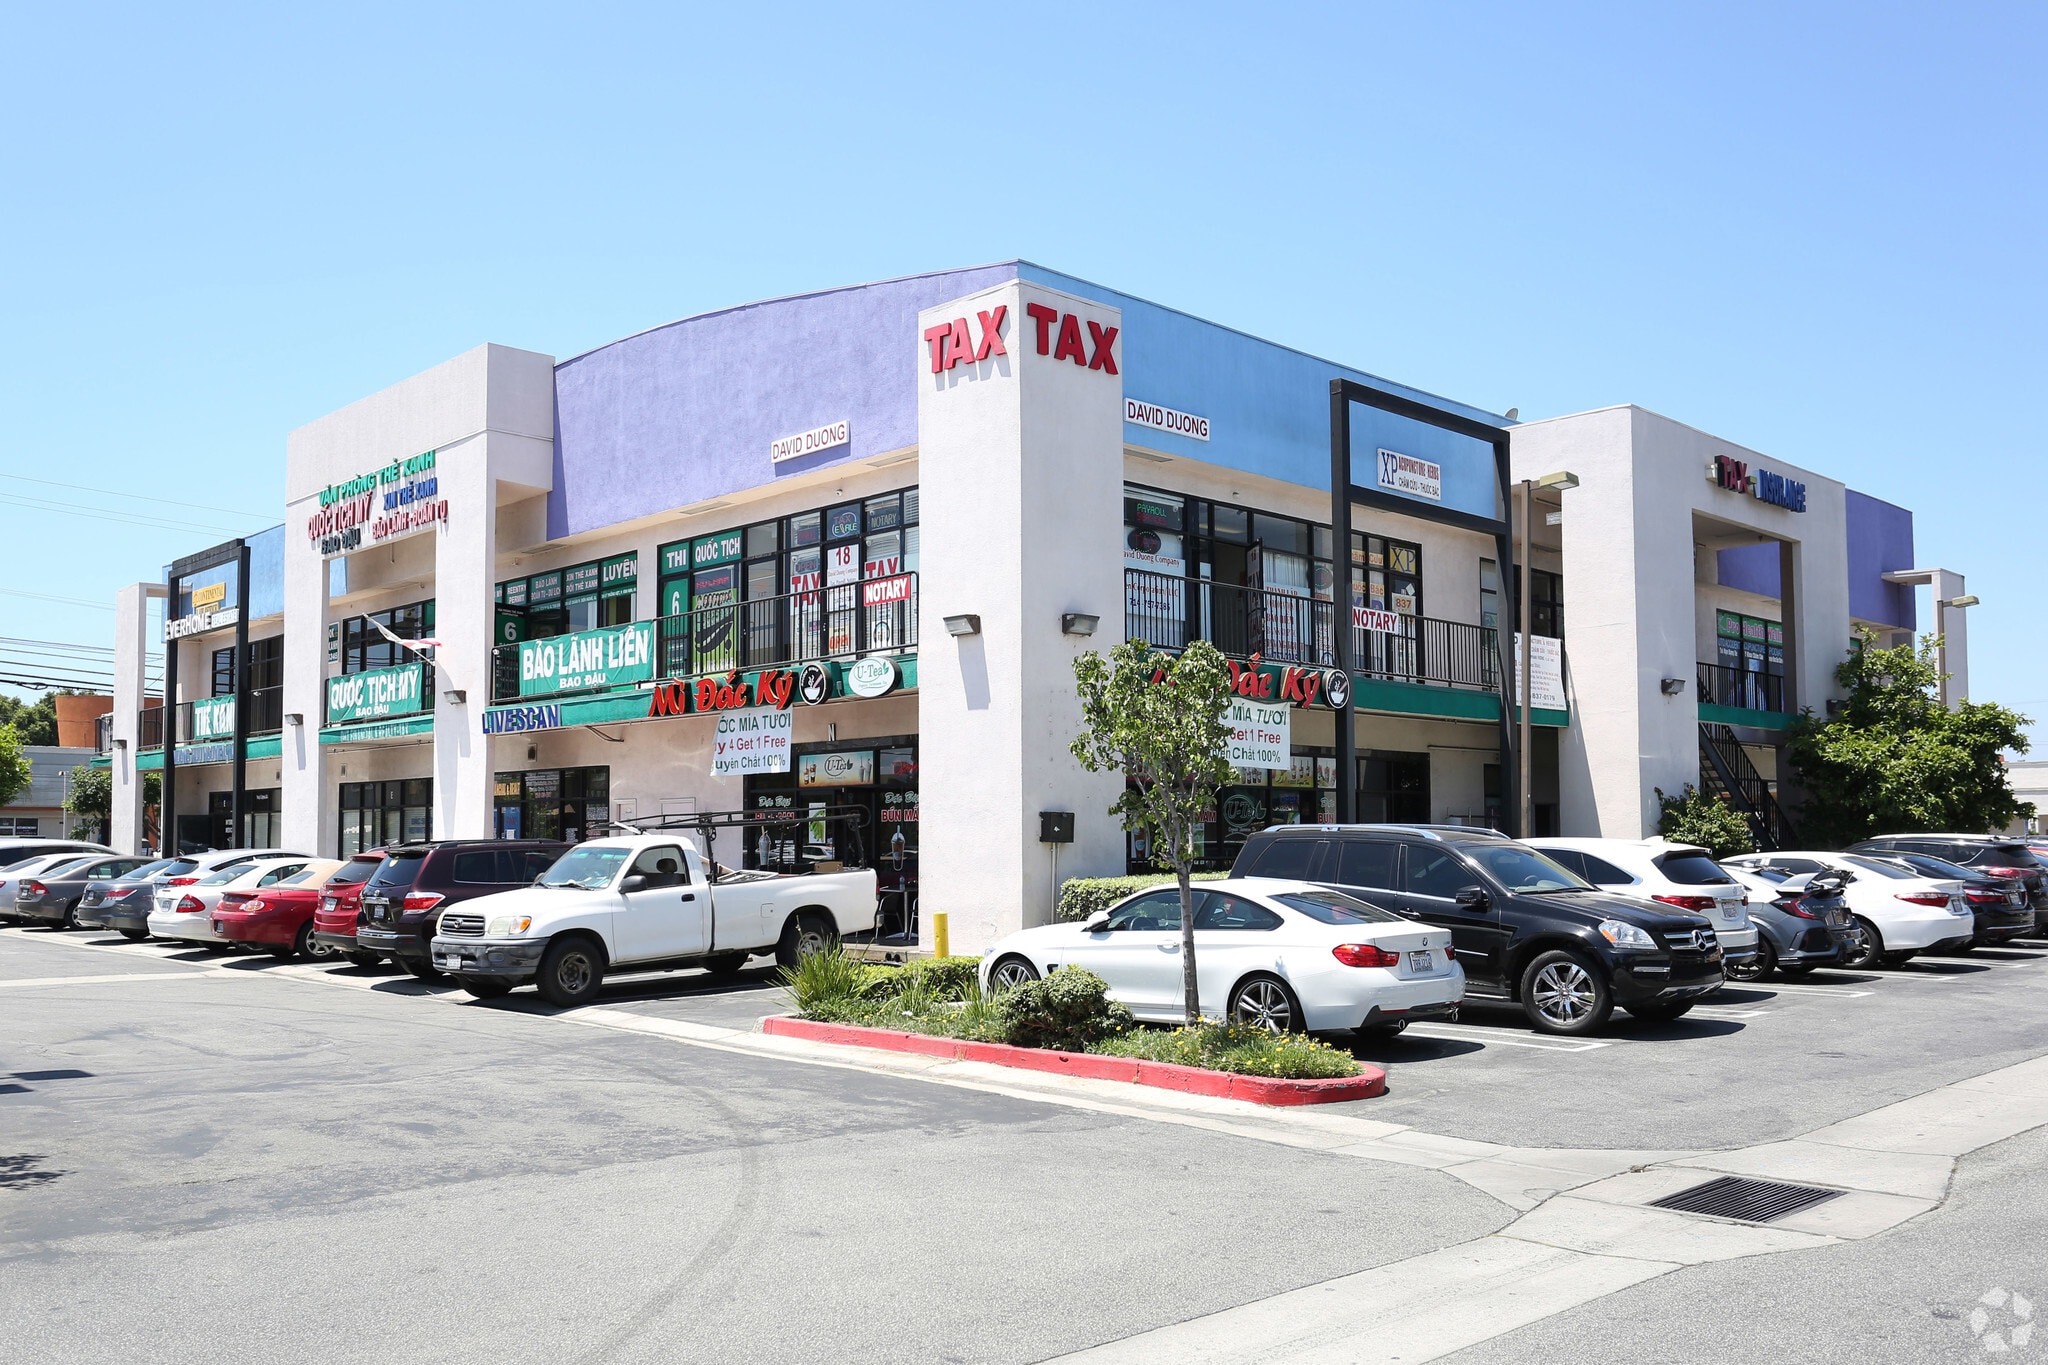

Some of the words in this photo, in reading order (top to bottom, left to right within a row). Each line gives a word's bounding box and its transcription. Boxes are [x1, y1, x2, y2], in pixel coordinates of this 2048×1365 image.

[925, 305, 1007, 373] TAX
[1027, 302, 1119, 375] TAX
[1128, 402, 1163, 425] DAVID
[1167, 411, 1207, 436] DUONG
[773, 437, 802, 460] DAVID
[806, 423, 845, 450] DUONG
[402, 450, 436, 478] XANH
[1382, 452, 1398, 485] XP
[414, 477, 437, 501] XANH
[1714, 455, 1749, 494] TAX
[1754, 468, 1806, 513] INSURANCE
[1137, 503, 1167, 517] PAYROLL
[871, 513, 896, 529] NOTARY
[321, 536, 340, 555] BAO
[695, 538, 718, 563] QUỐC
[721, 537, 740, 559] TỊCH
[667, 549, 687, 569] THI
[836, 546, 850, 566] 18
[1137, 551, 1154, 564] Duong
[1155, 555, 1180, 568] Company
[1391, 547, 1416, 573] XP
[604, 559, 637, 580] LUYỆN
[507, 584, 526, 594] REENTRY
[508, 594, 525, 604] PERMIT
[791, 572, 822, 608] TAX
[866, 578, 908, 604] NOTARY
[672, 591, 680, 616] 6
[1396, 598, 1411, 609] 837
[165, 612, 211, 640] EVERHOME
[1353, 608, 1398, 631] NOTARY
[1727, 618, 1740, 634] Pro
[505, 622, 516, 640] 6
[523, 641, 554, 681] BẢO
[558, 636, 602, 675] LÃNH
[856, 664, 883, 679] U-Tea
[331, 675, 364, 710] QUỐC
[367, 673, 396, 706] TỊCH
[398, 665, 419, 700] MỸ
[560, 676, 581, 689] BAO
[648, 677, 685, 717] Mì
[693, 668, 747, 712] Đắc
[755, 669, 793, 711] Ký
[1281, 666, 1320, 709] Ký
[355, 707, 372, 717] BAO
[482, 704, 560, 734] LIVESCAN
[1233, 703, 1252, 722] MÍA
[1257, 709, 1287, 725] TƯƠI
[739, 713, 759, 732] MÍA
[762, 713, 790, 729] TƯƠI
[828, 723, 835, 741] N
[729, 738, 734, 751] 4
[737, 738, 753, 750] Get
[757, 736, 760, 749] 1
[764, 735, 786, 748] Free
[1249, 729, 1254, 741] 1
[1258, 729, 1281, 744] Free
[741, 754, 760, 768] Chất
[763, 754, 786, 766] 100%
[1232, 745, 1255, 760] Chất
[1257, 749, 1281, 763] 100%
[827, 759, 847, 771] U-Tea
[881, 806, 901, 822] BÚN
